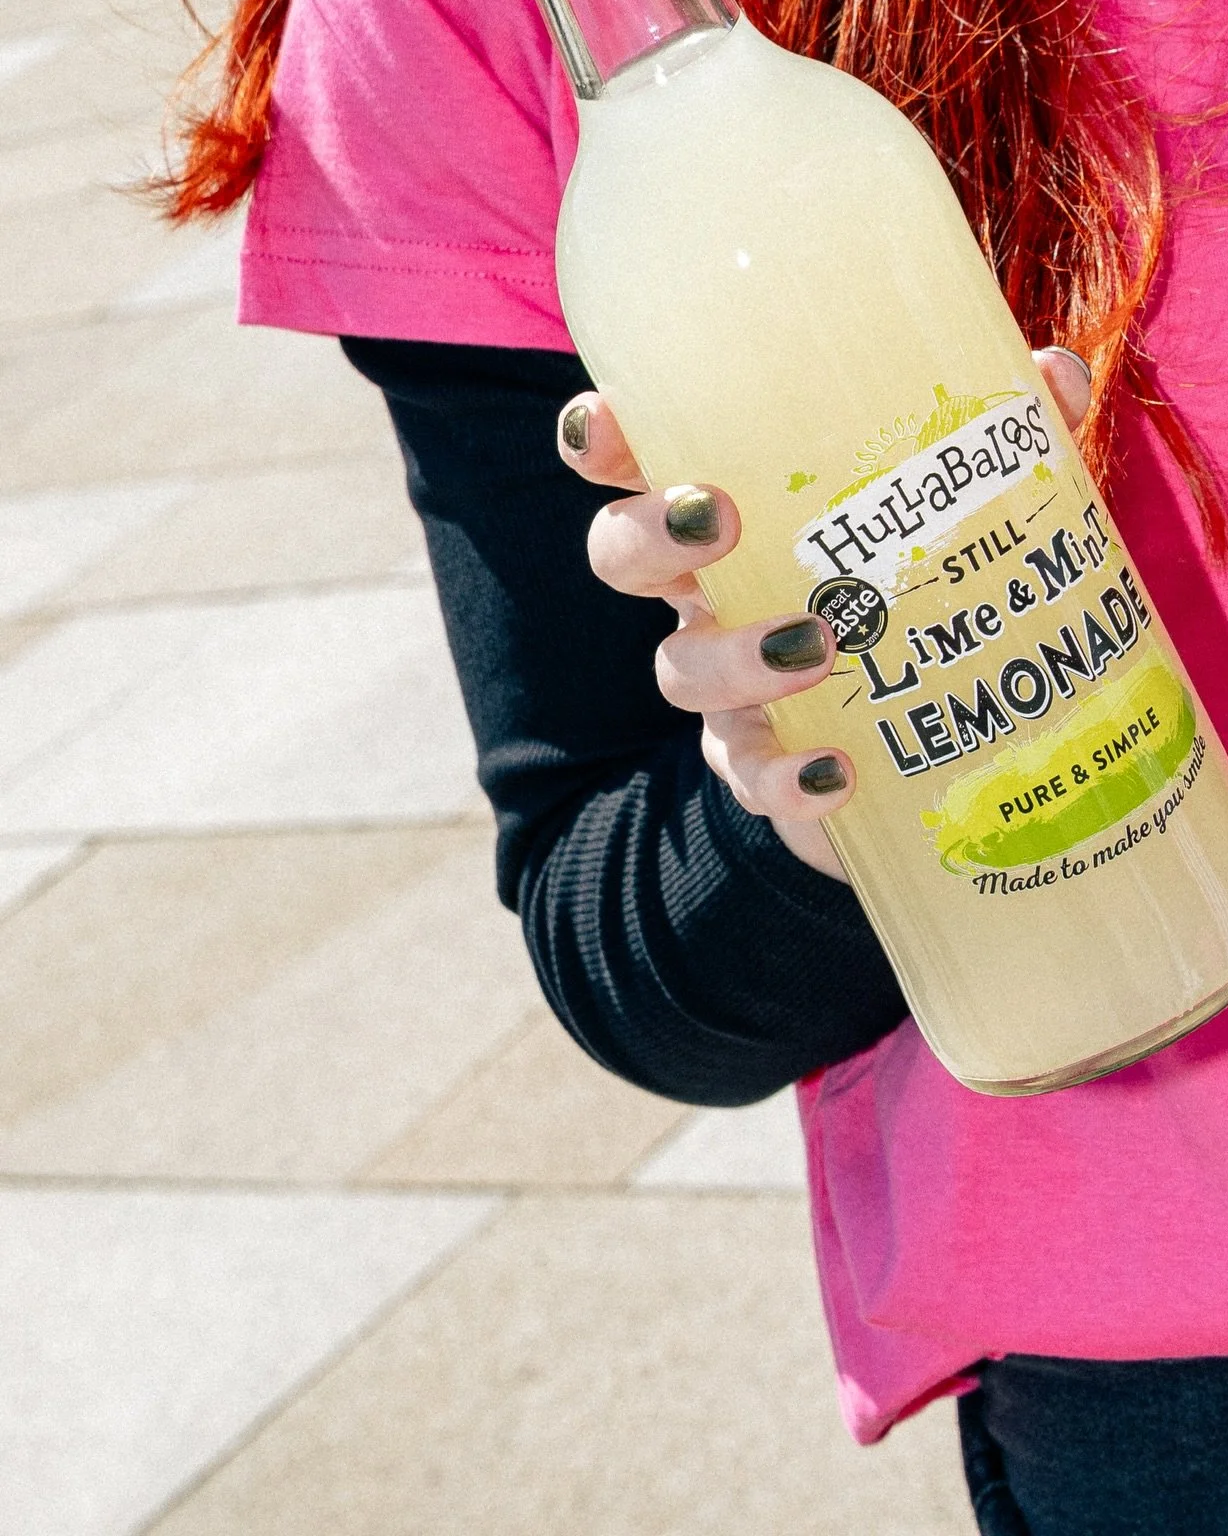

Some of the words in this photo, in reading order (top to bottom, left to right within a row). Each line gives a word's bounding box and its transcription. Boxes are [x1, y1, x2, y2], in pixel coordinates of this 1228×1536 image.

[942, 520, 1026, 584] STILL
[821, 588, 851, 622] great
[831, 590, 879, 643] aste
[1008, 579, 1036, 615] &
[866, 632, 880, 646] 2019
[876, 566, 1151, 777] LEMONADE
[998, 775, 1067, 823] PURE
[1072, 764, 1090, 785] &
[1092, 707, 1160, 770] SIMPLE
[973, 866, 1058, 895] Made
[1062, 858, 1089, 879] to
[1093, 821, 1152, 867] make
[1153, 790, 1185, 834] you
[1184, 735, 1206, 789] smile
